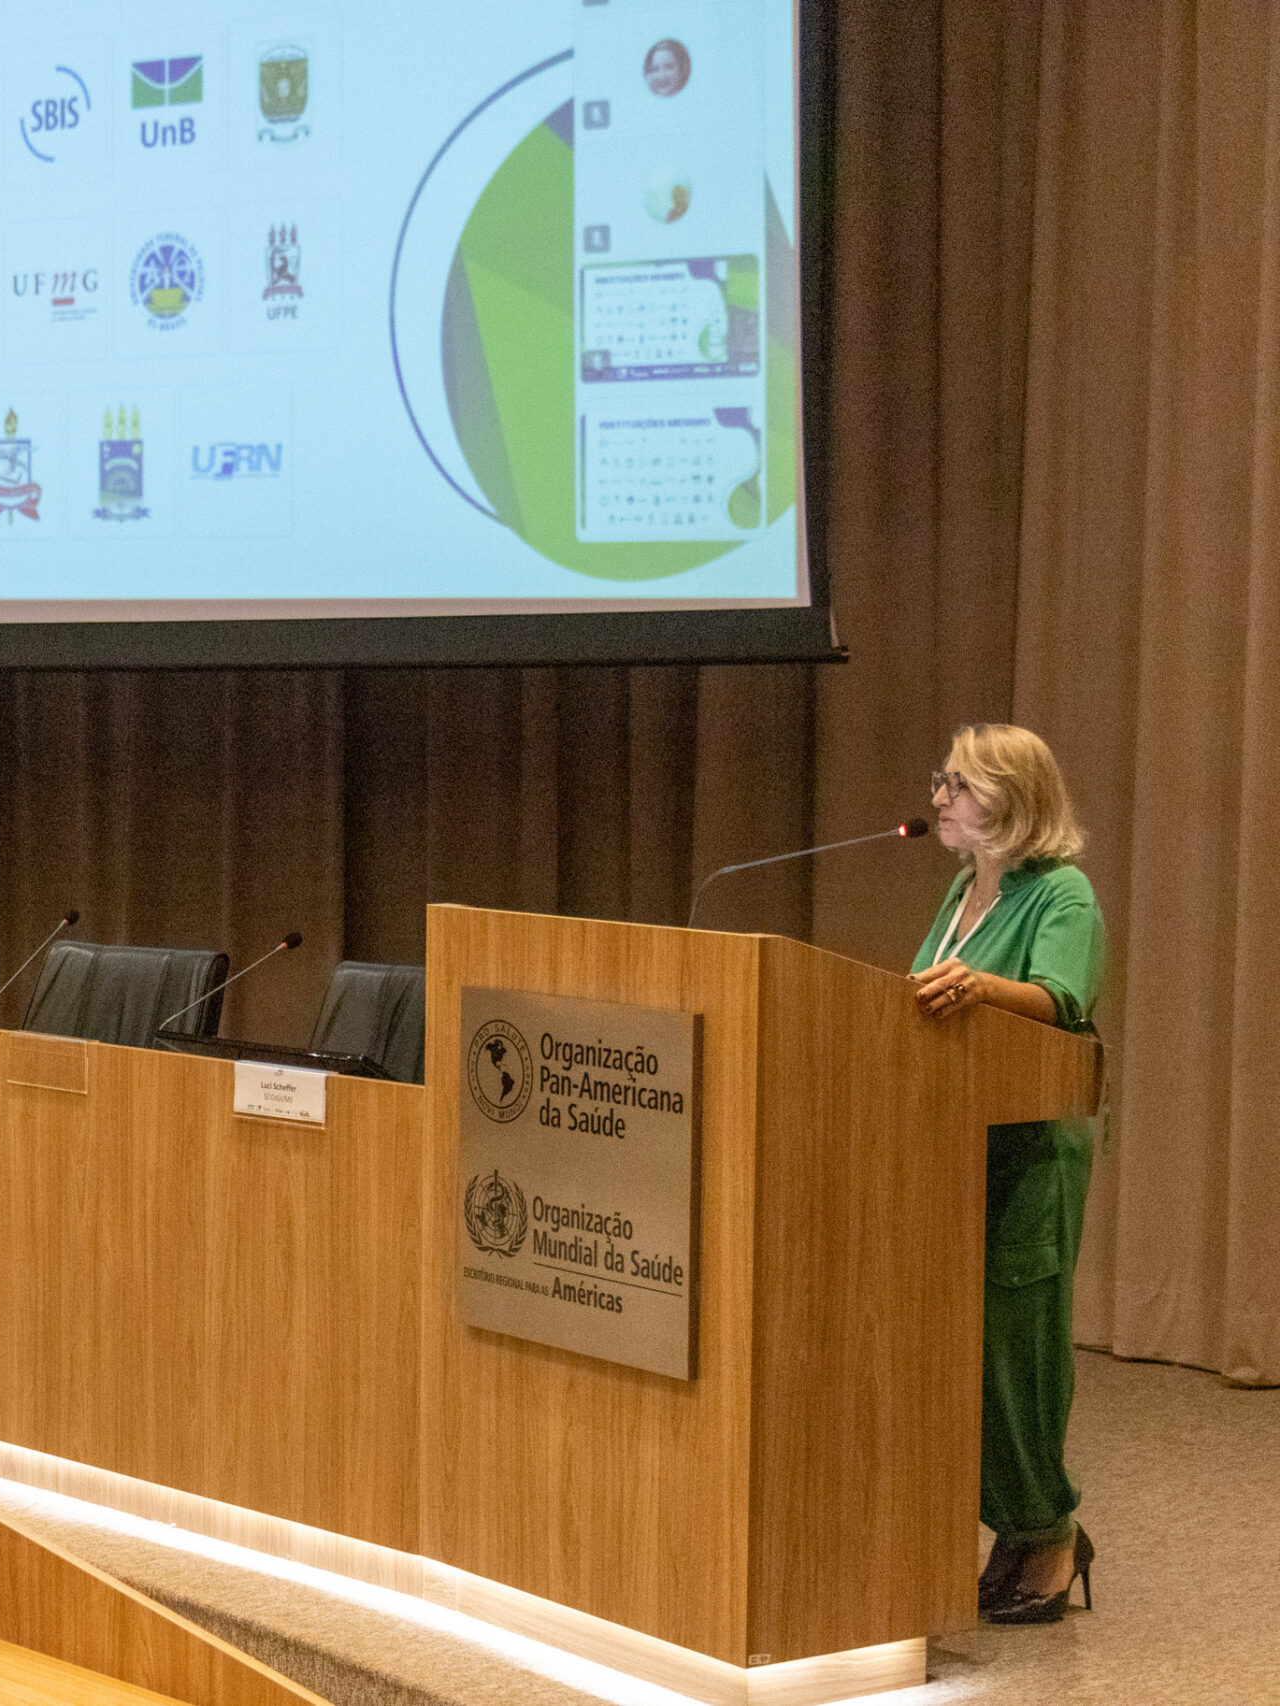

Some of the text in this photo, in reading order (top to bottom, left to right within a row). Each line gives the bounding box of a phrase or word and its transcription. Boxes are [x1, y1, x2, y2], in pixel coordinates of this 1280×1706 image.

[31, 97, 79, 132] SBIS
[140, 118, 196, 148] UnB
[266, 305, 299, 321] UFPE
[474, 1023, 526, 1052] PRO SALUTE
[540, 1033, 658, 1082] Organização
[540, 1065, 683, 1115] Pan-Americana
[539, 1097, 625, 1139] da Saúde
[532, 1195, 633, 1244] Organização
[533, 1229, 683, 1286] Mundial da Saúde
[463, 1266, 623, 1314] ESCRITÓRIO REGIONAL PARA AS Américas
